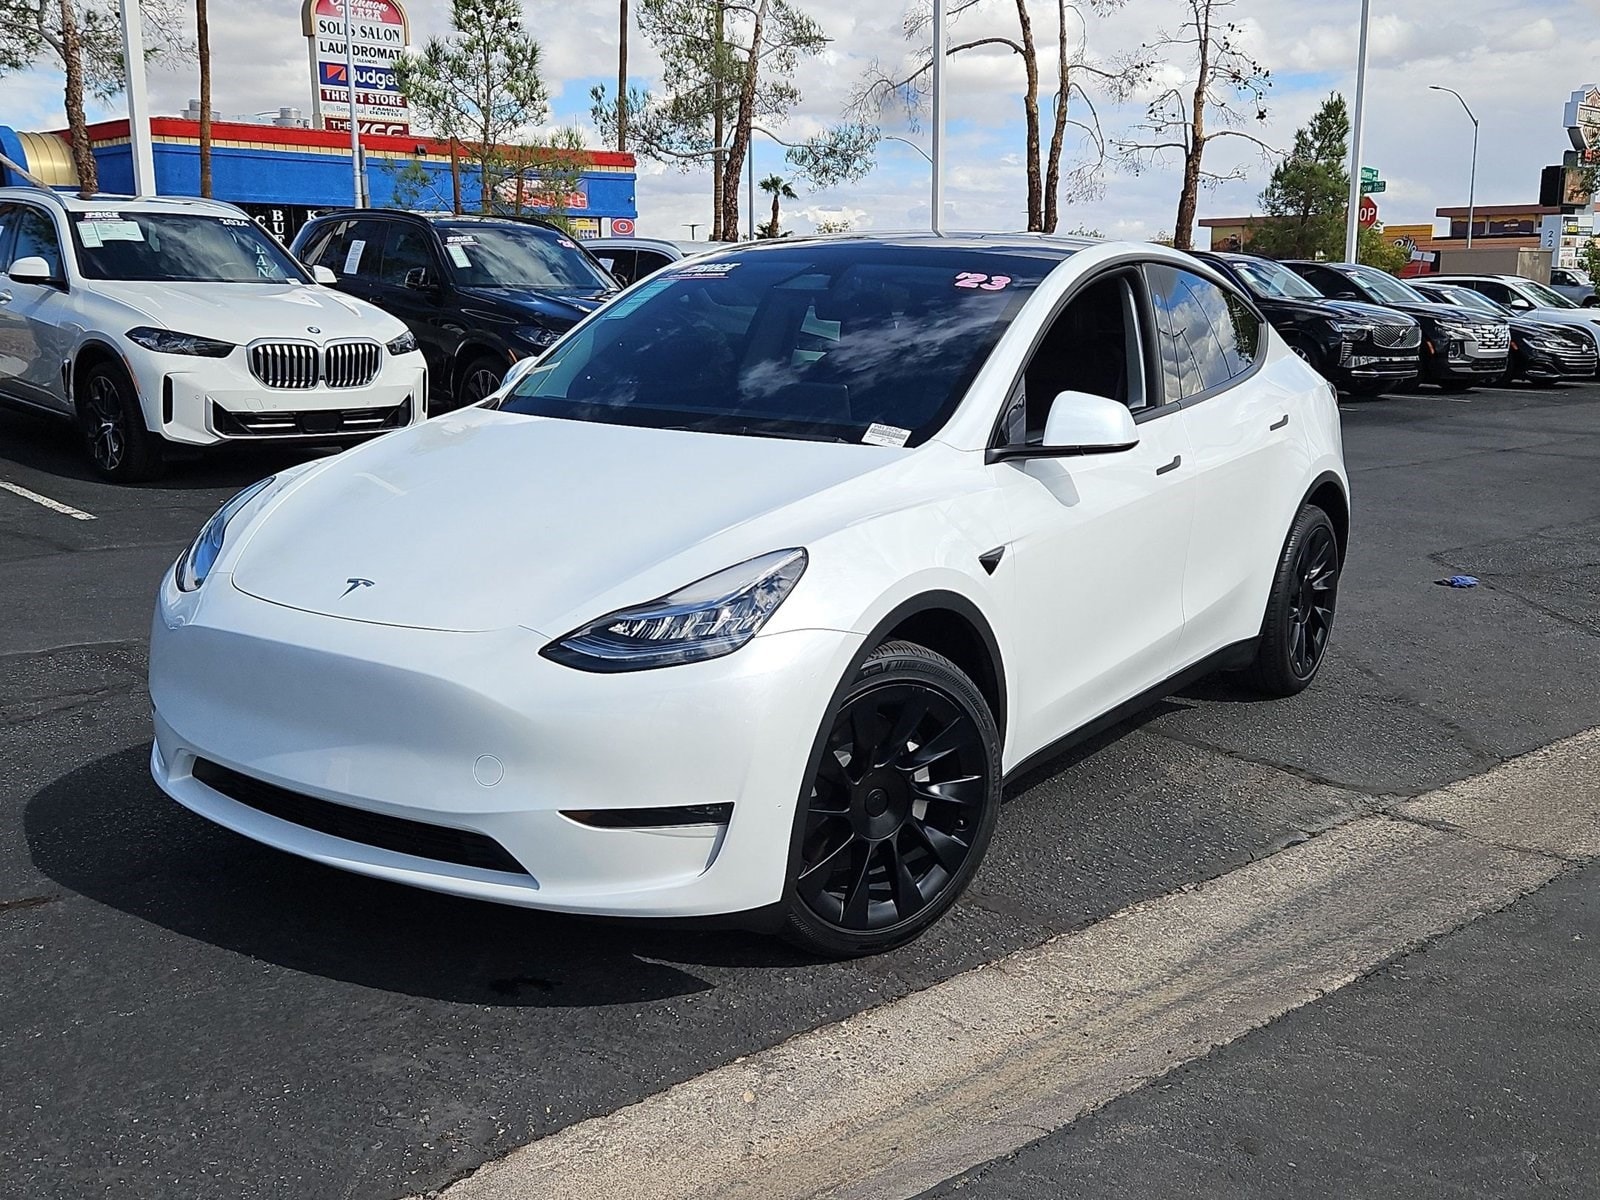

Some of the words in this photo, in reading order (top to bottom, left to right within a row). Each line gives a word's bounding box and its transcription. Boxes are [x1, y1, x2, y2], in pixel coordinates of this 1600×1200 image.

[360, 25, 400, 42] SALON
[368, 93, 403, 106] STORE
[1359, 207, 1376, 221] OP
